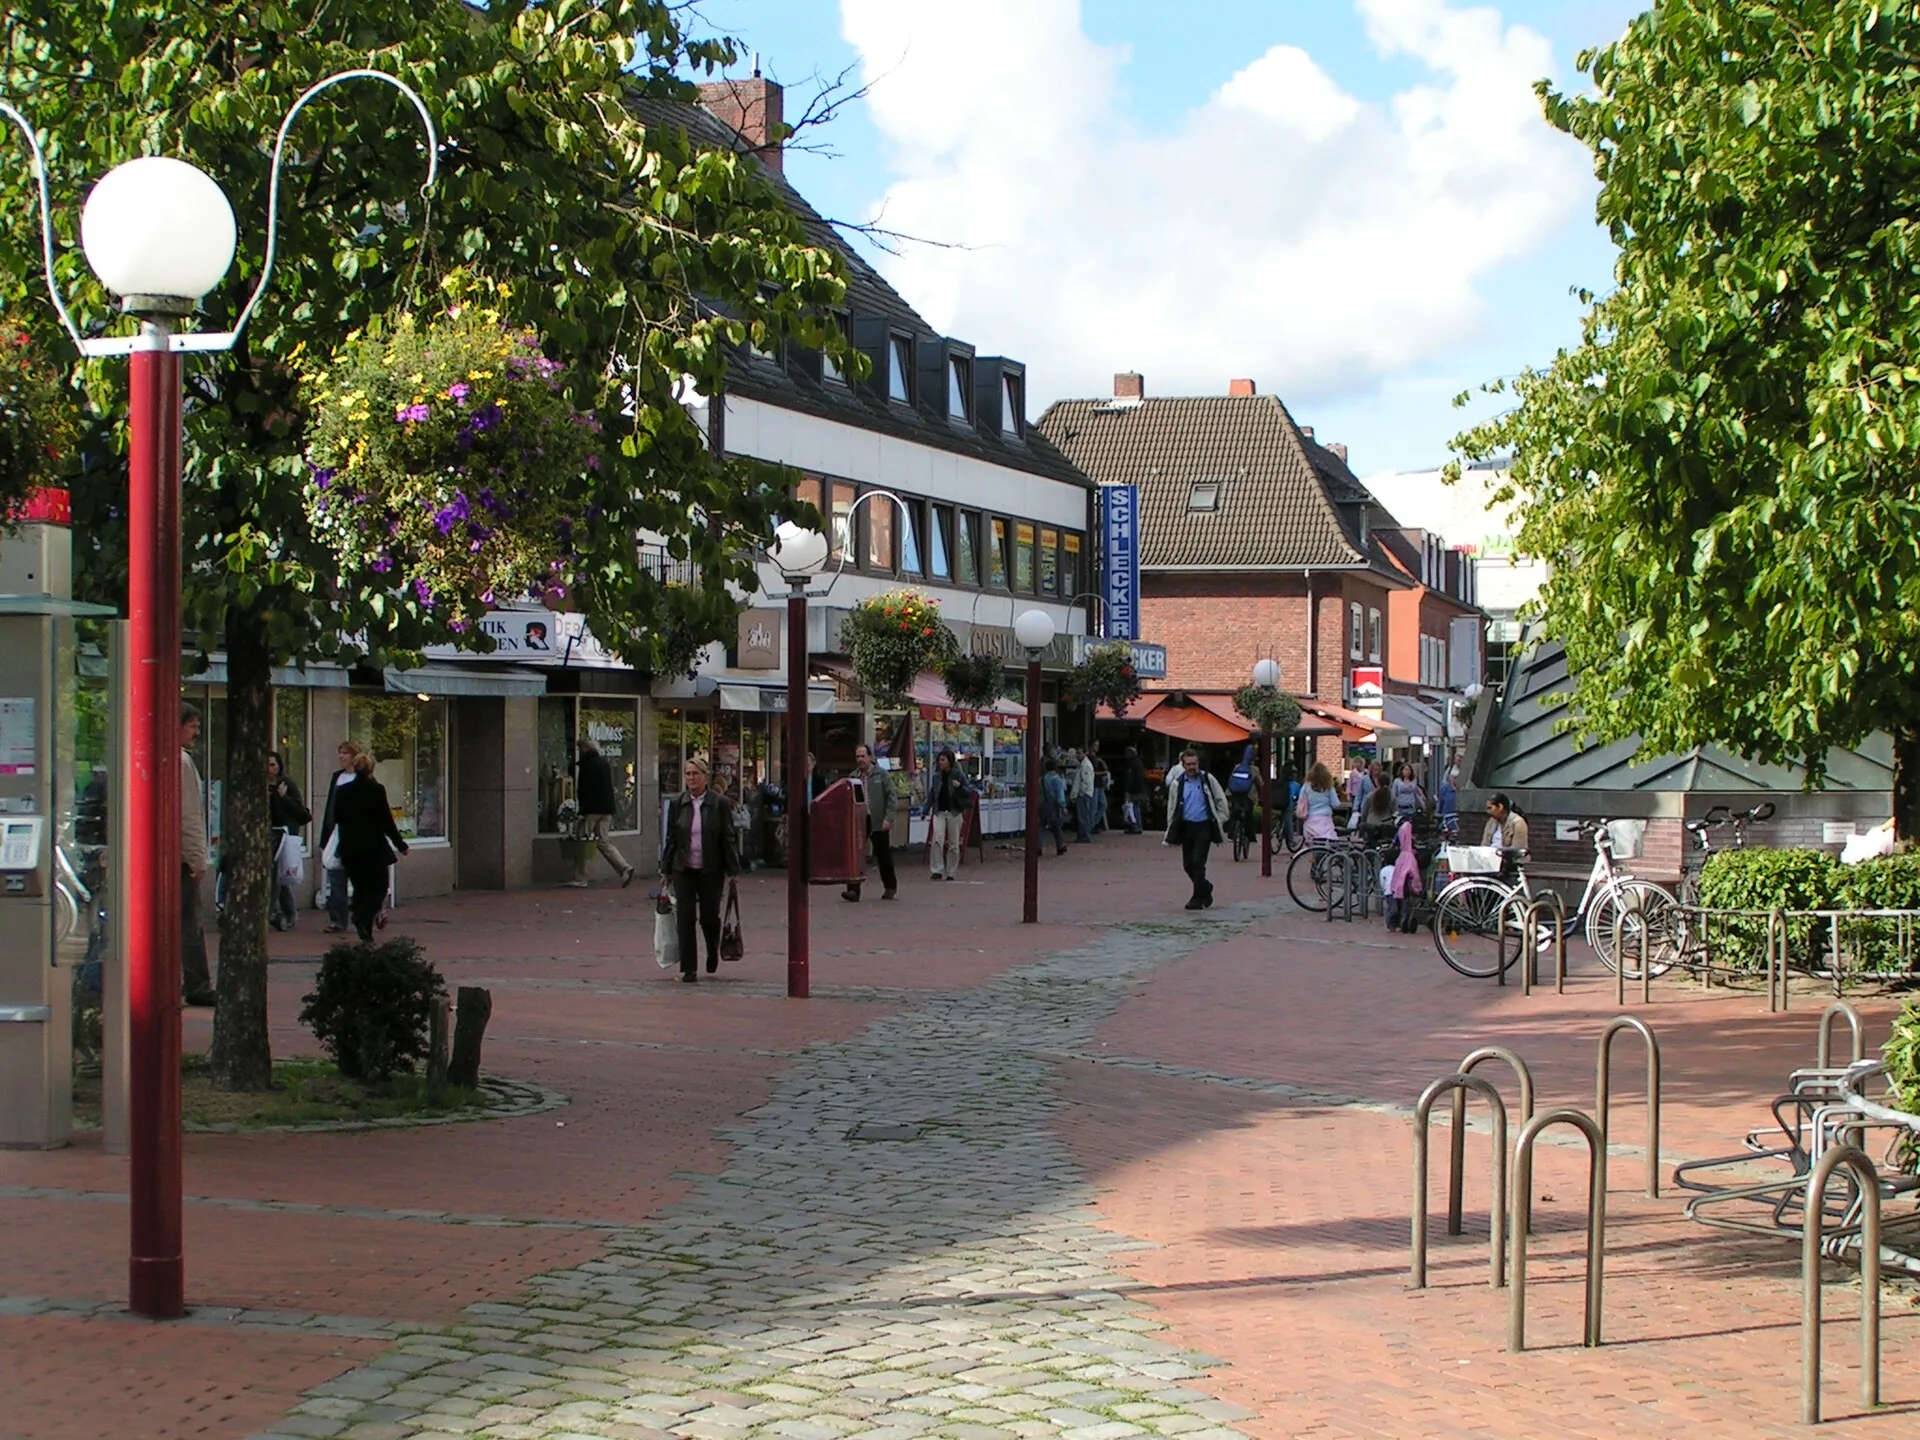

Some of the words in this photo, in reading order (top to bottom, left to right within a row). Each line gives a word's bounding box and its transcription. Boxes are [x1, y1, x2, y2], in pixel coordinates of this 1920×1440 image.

[1111, 489, 1129, 637] SCHLECKER
[480, 621, 506, 634] TIK
[498, 638, 519, 651] EN
